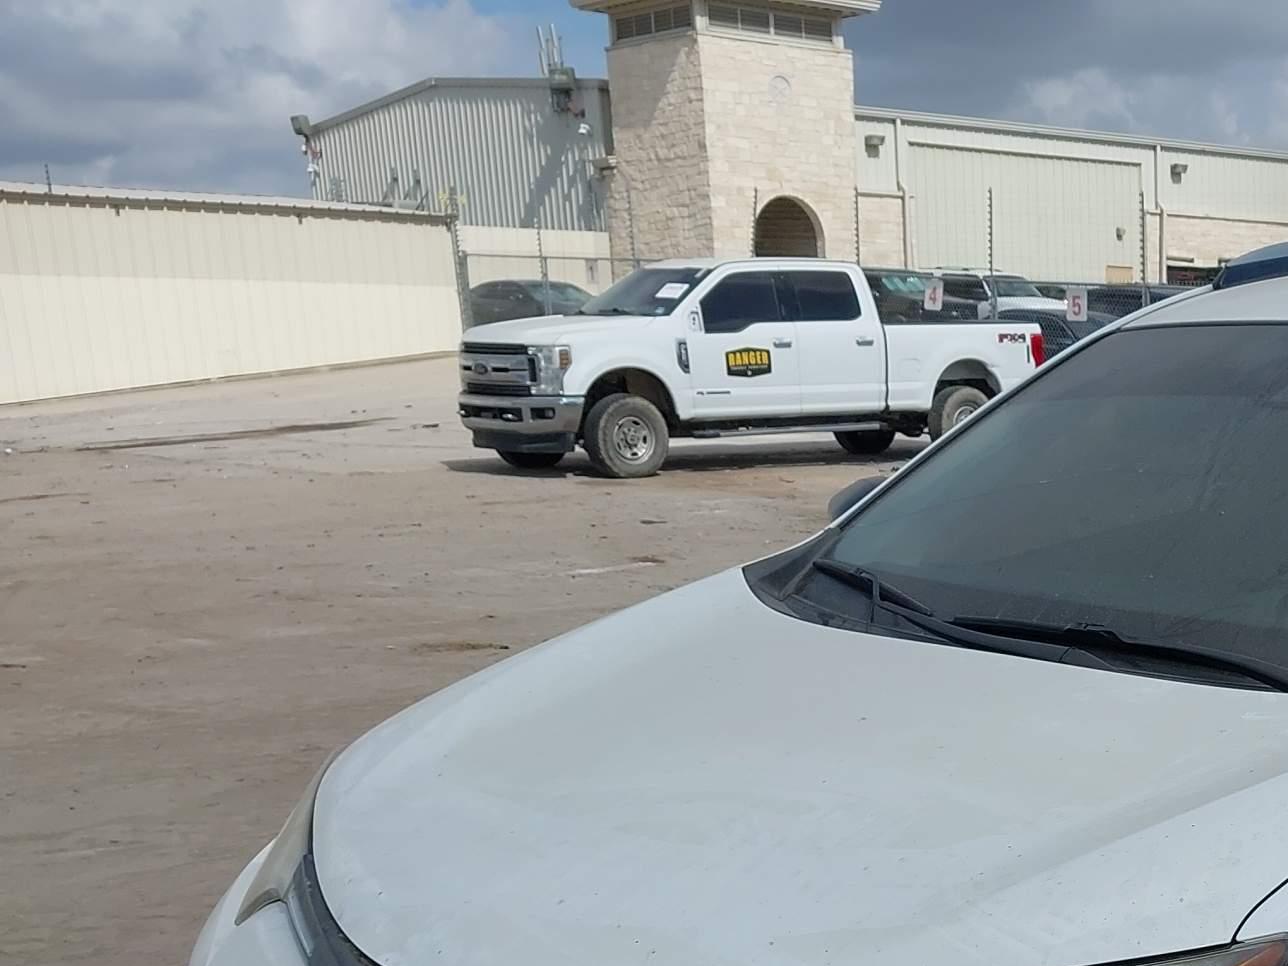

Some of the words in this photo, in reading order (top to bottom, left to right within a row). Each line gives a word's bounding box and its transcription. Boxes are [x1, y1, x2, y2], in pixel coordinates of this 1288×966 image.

[929, 286, 937, 305] 4
[1072, 295, 1082, 316] 5
[727, 350, 769, 366] RANGER
